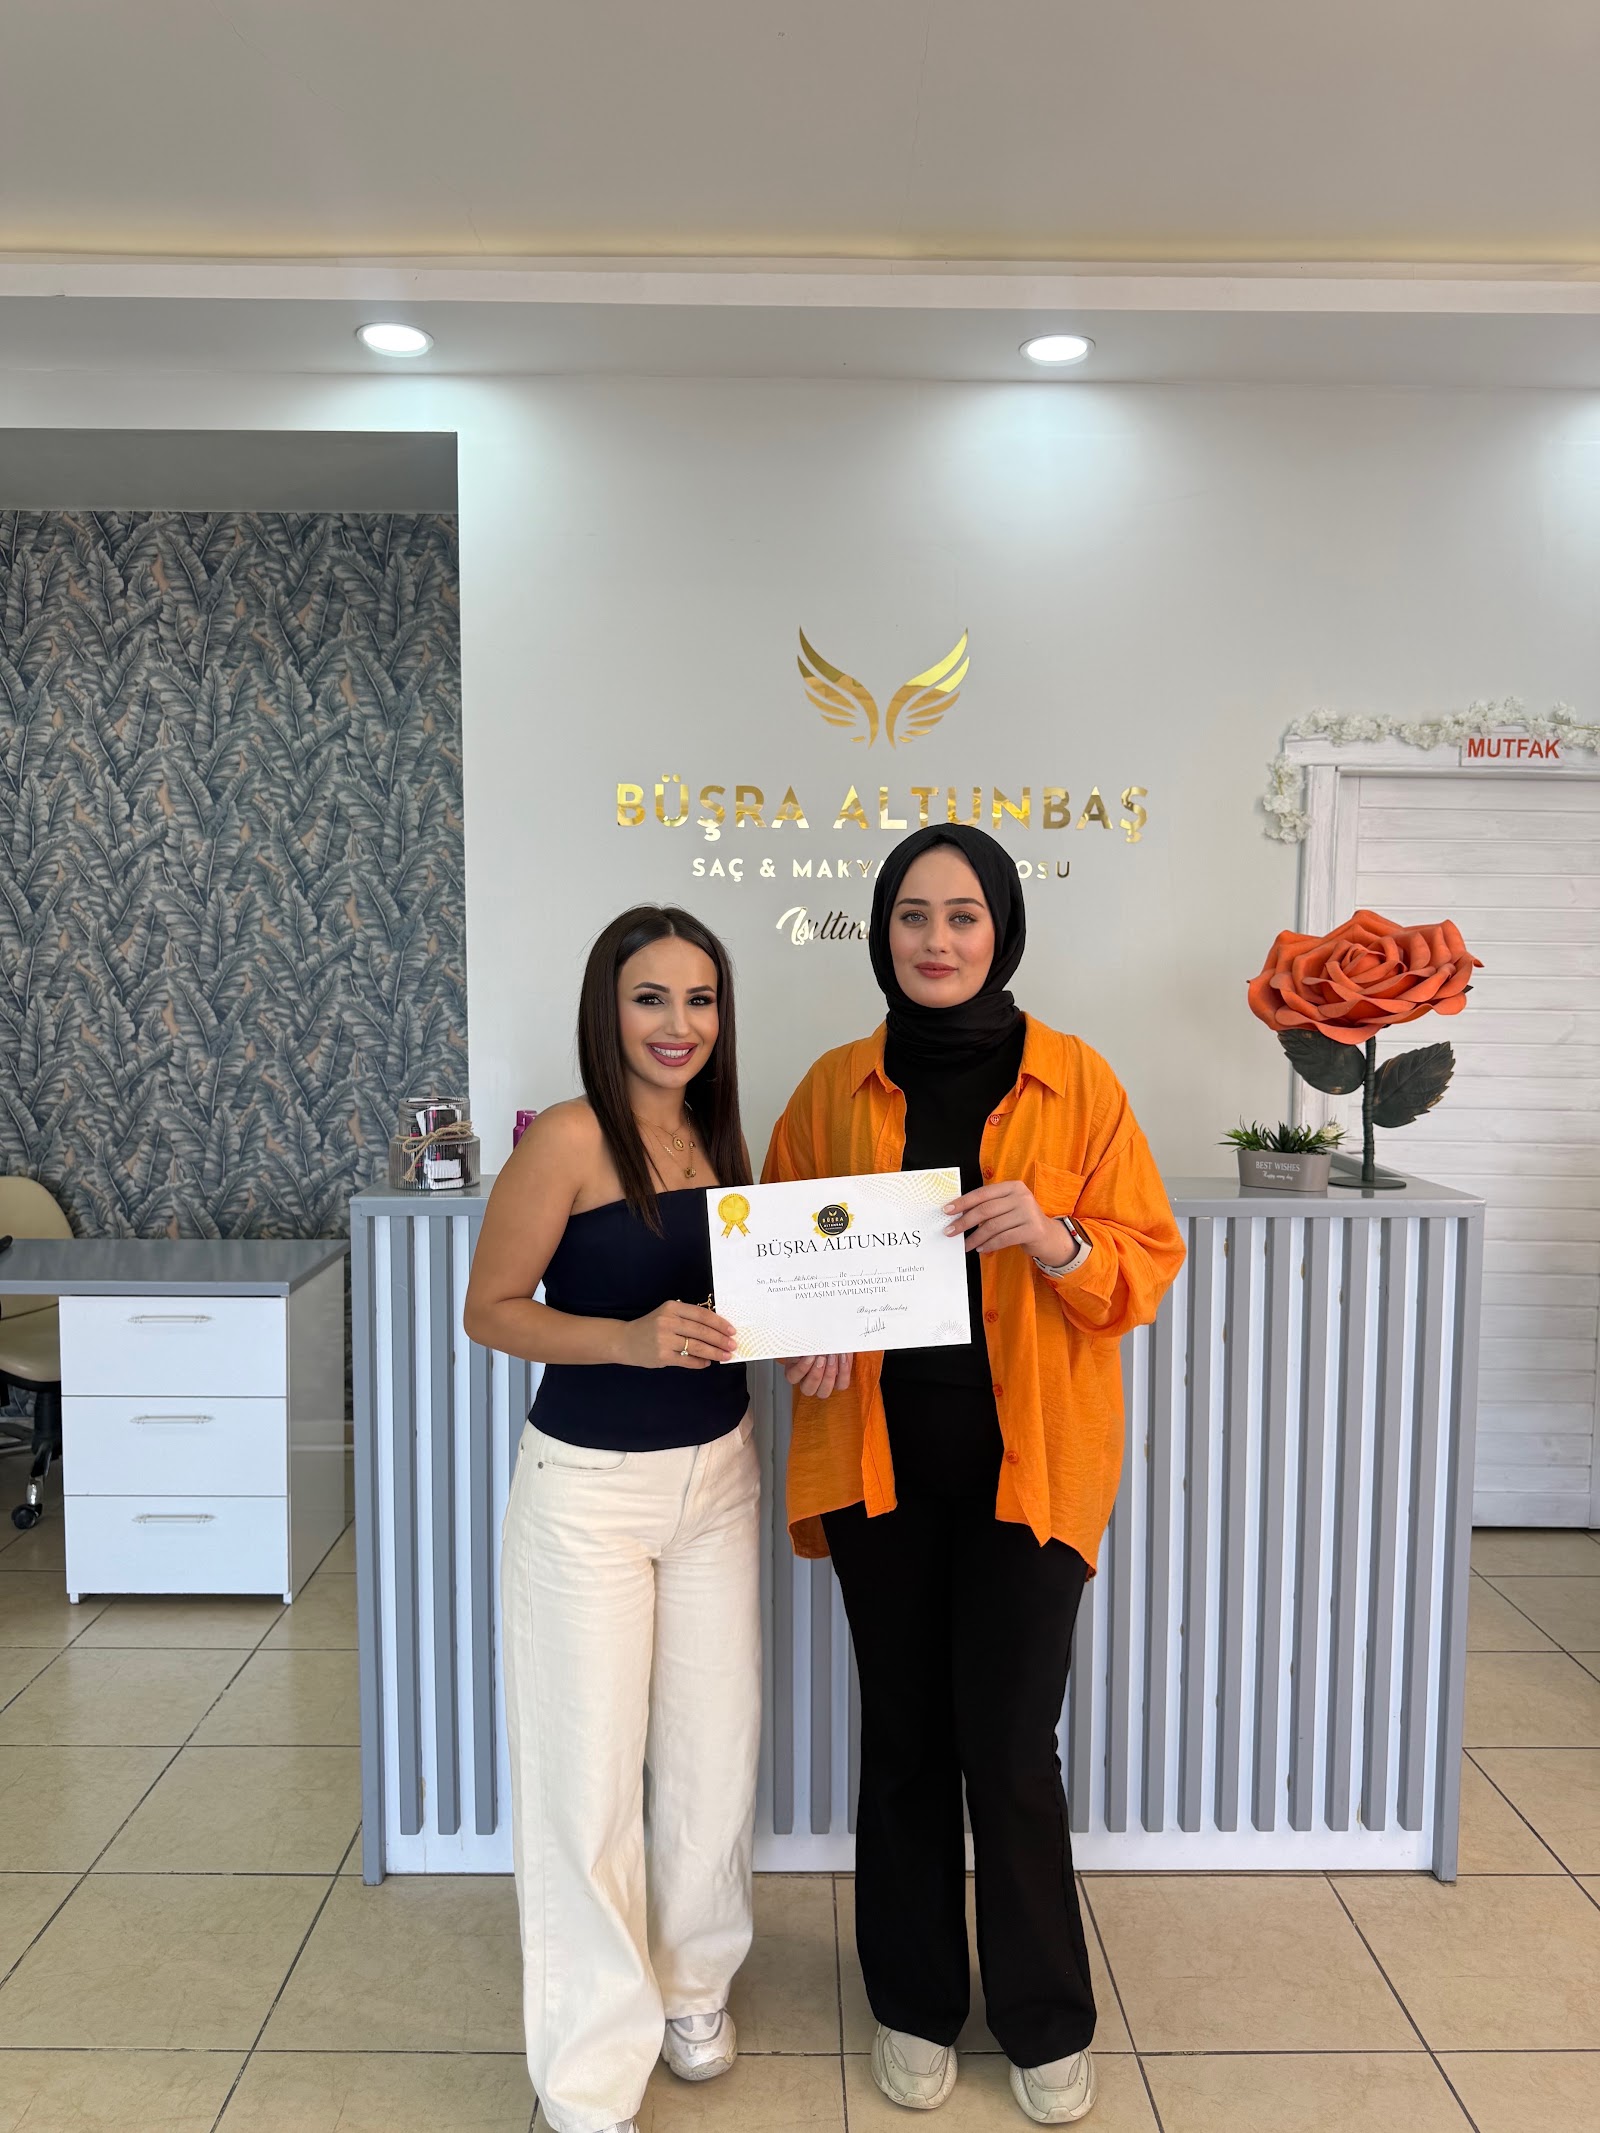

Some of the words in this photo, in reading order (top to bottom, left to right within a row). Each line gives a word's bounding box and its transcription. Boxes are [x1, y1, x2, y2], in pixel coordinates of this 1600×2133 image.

[1467, 737, 1561, 759] MUTFAK
[616, 773, 811, 841] BÜŞRA
[833, 784, 1150, 844] ALTUNBAŞ
[692, 857, 745, 882] SAÇ
[759, 858, 777, 877] &
[1255, 1161, 1272, 1170] BEST
[1274, 1162, 1300, 1172] WISHES
[756, 1239, 818, 1259] BÜŞRA
[823, 1230, 922, 1252] ALTUNBAŞ
[797, 1281, 830, 1291] KUAFÖR
[831, 1276, 893, 1288] STÜDYOMUZDA
[894, 1273, 915, 1283] BİLGİ
[795, 1290, 835, 1300] PAYLAŞIMI
